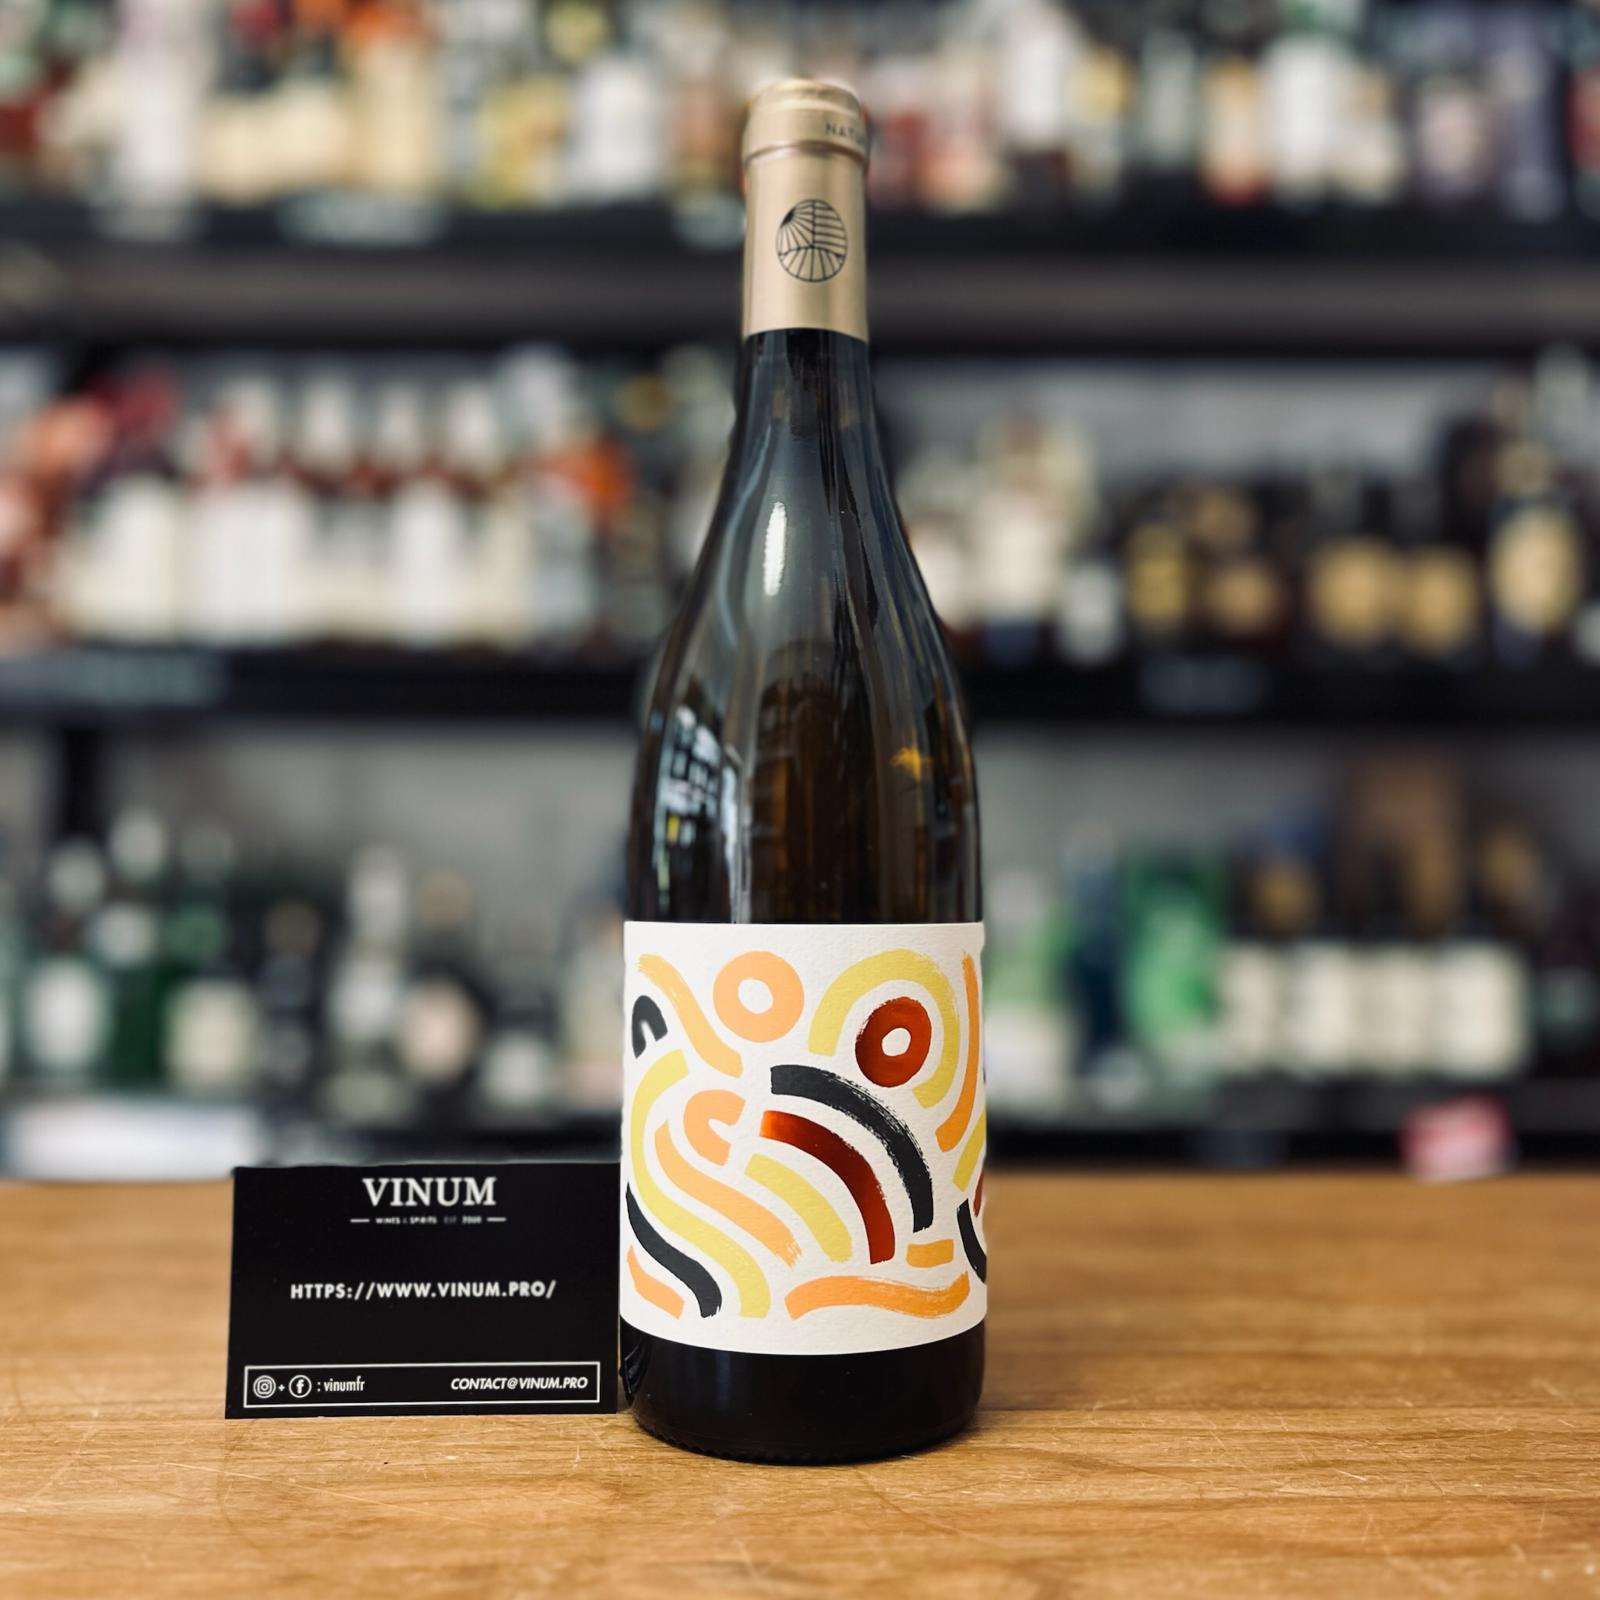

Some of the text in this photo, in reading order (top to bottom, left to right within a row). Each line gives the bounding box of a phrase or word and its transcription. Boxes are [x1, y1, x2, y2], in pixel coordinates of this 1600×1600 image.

[362, 1177, 497, 1207] VINUM
[290, 1280, 556, 1300] HTTPS://WWW.VINUM.PRO/
[324, 1375, 366, 1392] vinumfr
[451, 1377, 589, 1390] CONTACT@VINUM.PRO
